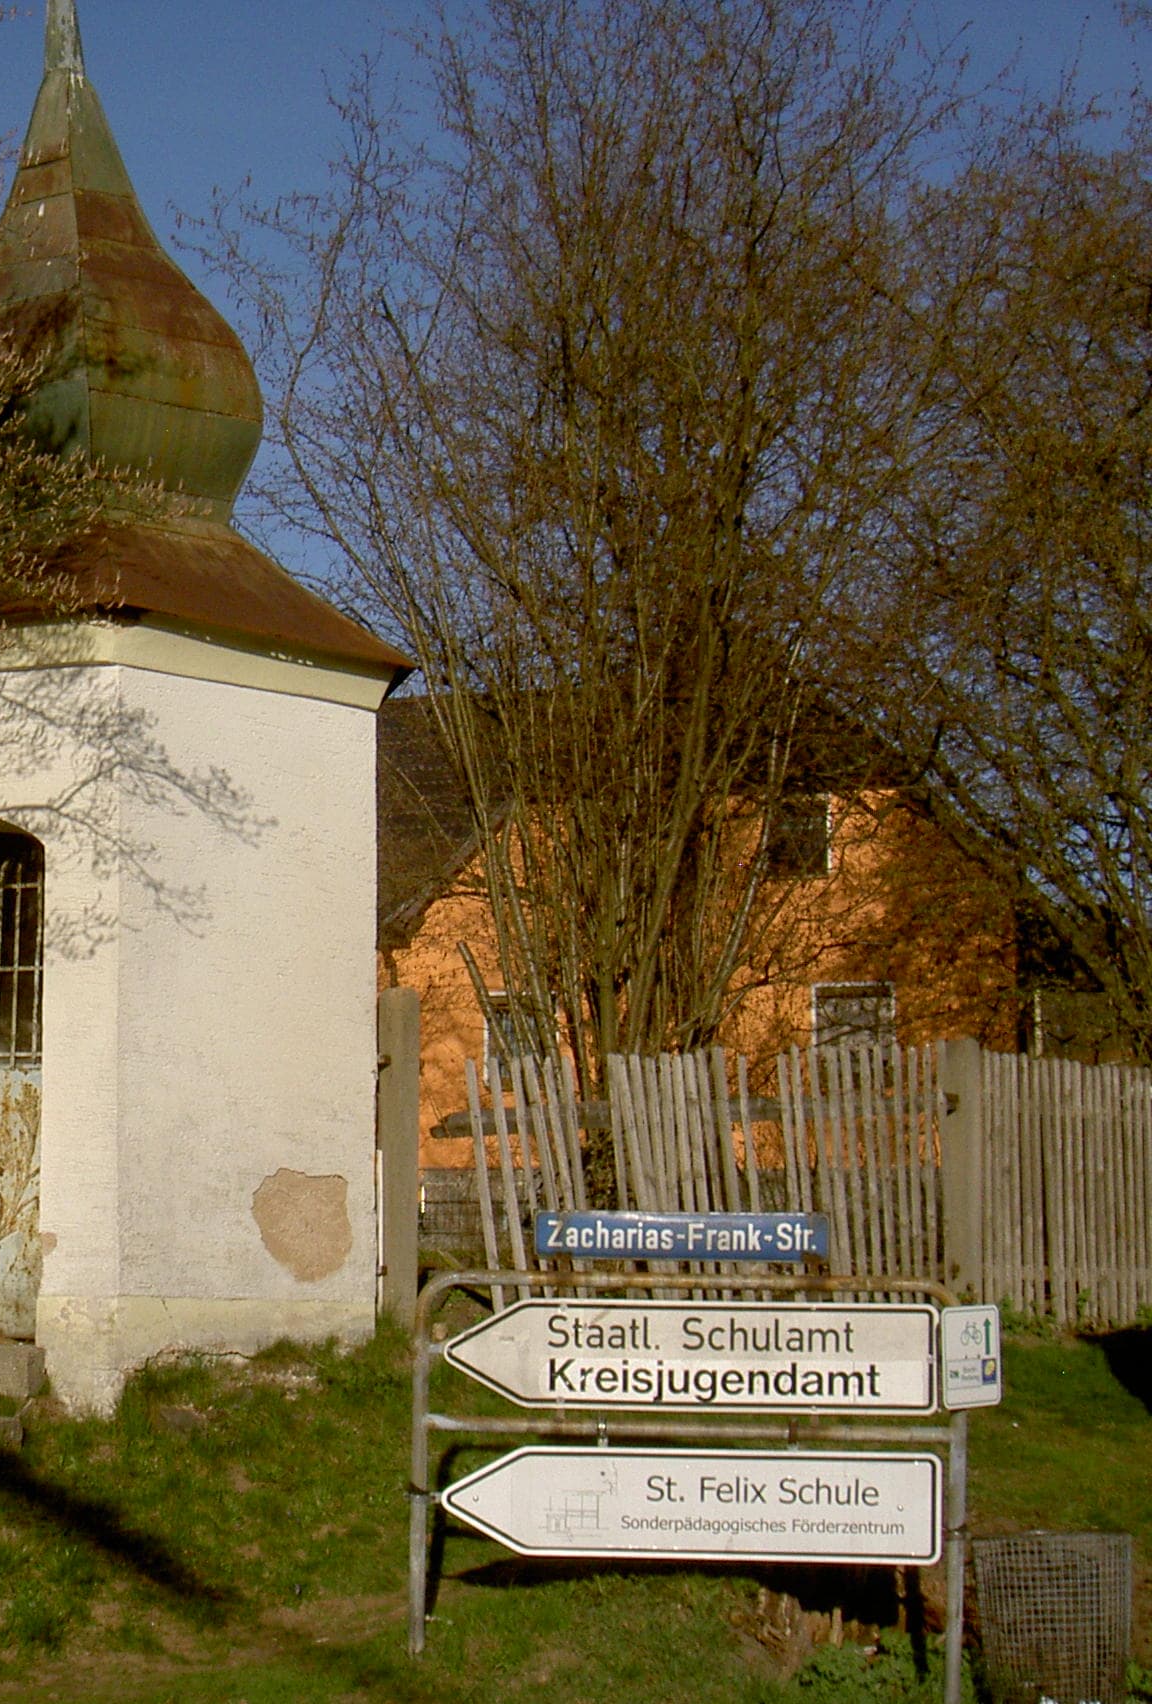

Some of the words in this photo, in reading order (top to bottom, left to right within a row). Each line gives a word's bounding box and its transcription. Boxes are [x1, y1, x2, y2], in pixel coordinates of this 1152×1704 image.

[546, 1219, 817, 1252] Zacharias-Frank-Str.
[546, 1315, 660, 1350] Staatl.
[682, 1317, 854, 1353] Schulamt
[548, 1358, 880, 1402] Kreisjugendamt
[646, 1475, 685, 1503] St.
[699, 1476, 767, 1504] Felix
[779, 1478, 880, 1507] Schule
[620, 1514, 786, 1535] Sonderpädagogisches
[791, 1517, 906, 1536] Förderzentrum
